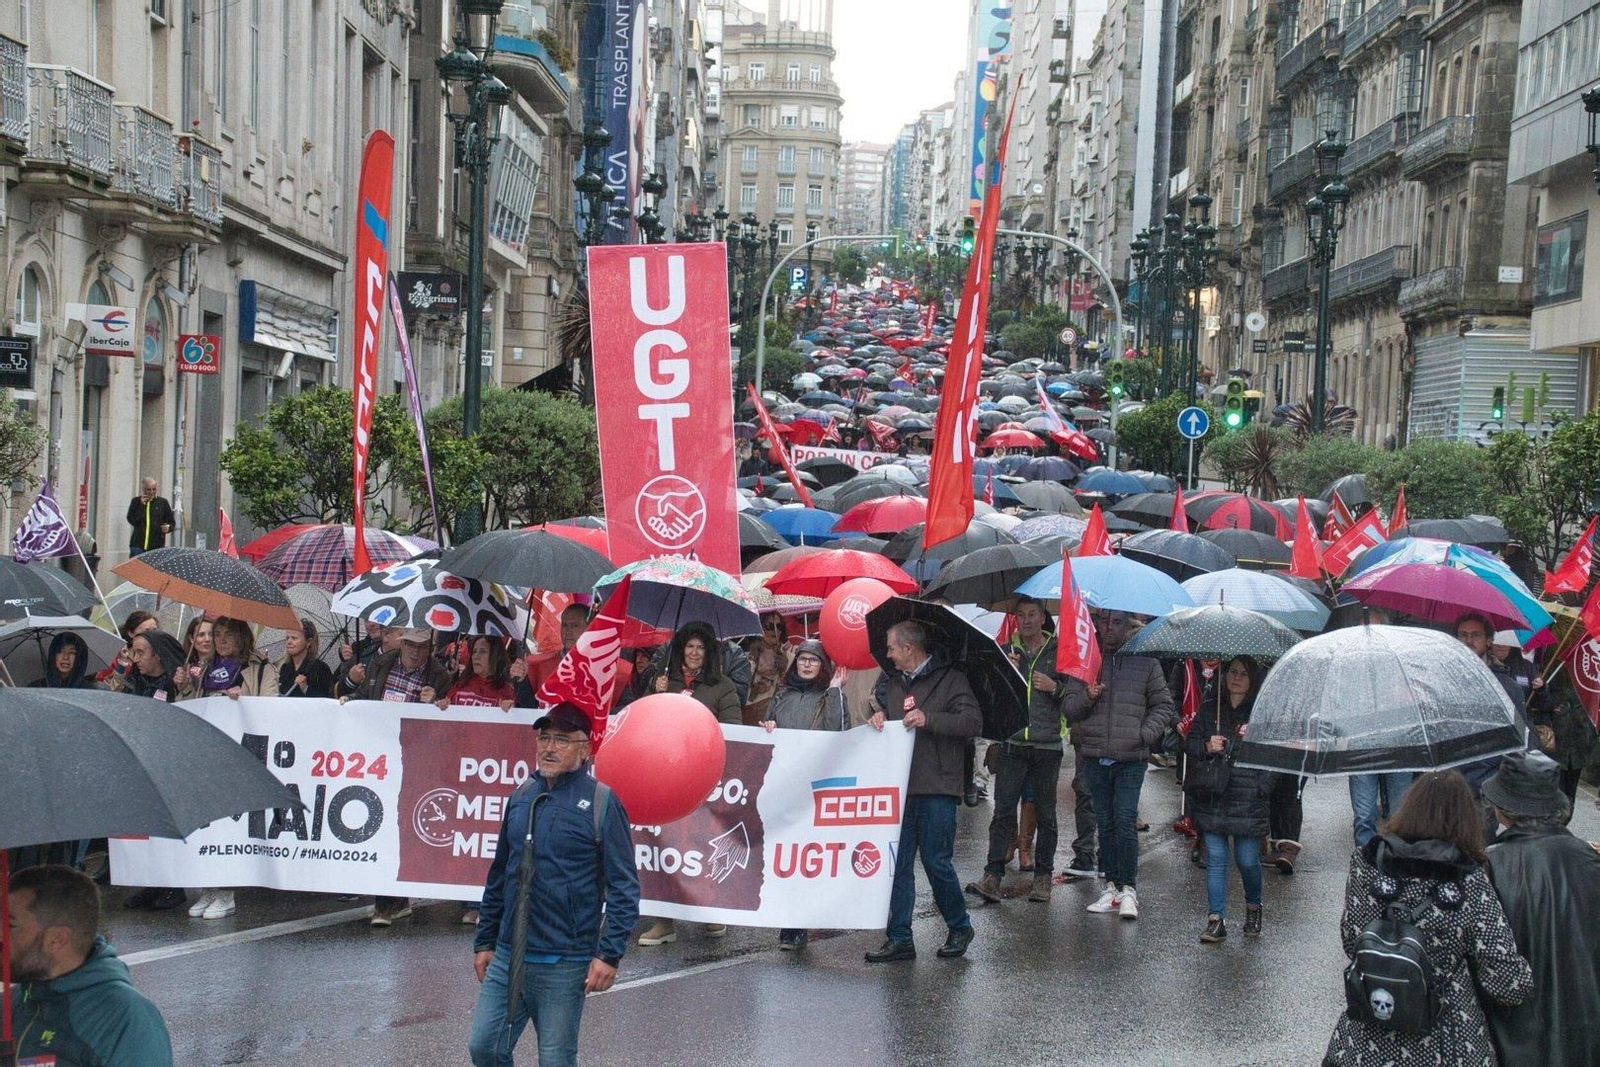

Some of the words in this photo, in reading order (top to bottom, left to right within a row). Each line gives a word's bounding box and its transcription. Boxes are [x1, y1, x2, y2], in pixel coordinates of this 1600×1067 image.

[793, 268, 805, 281] P
[408, 292, 458, 304] Peregrinus
[89, 336, 130, 347] iberCaja
[629, 255, 690, 471] UGT
[841, 599, 870, 613] UGT
[311, 750, 388, 780] 2024
[459, 757, 529, 786] POLO
[456, 795, 509, 821] ME
[820, 795, 893, 818] CCOO
[199, 844, 290, 859] #PLENOEMPREGO
[300, 849, 378, 863] #1MAIO2024
[635, 844, 704, 877] RIOS
[773, 842, 846, 878] UGT
